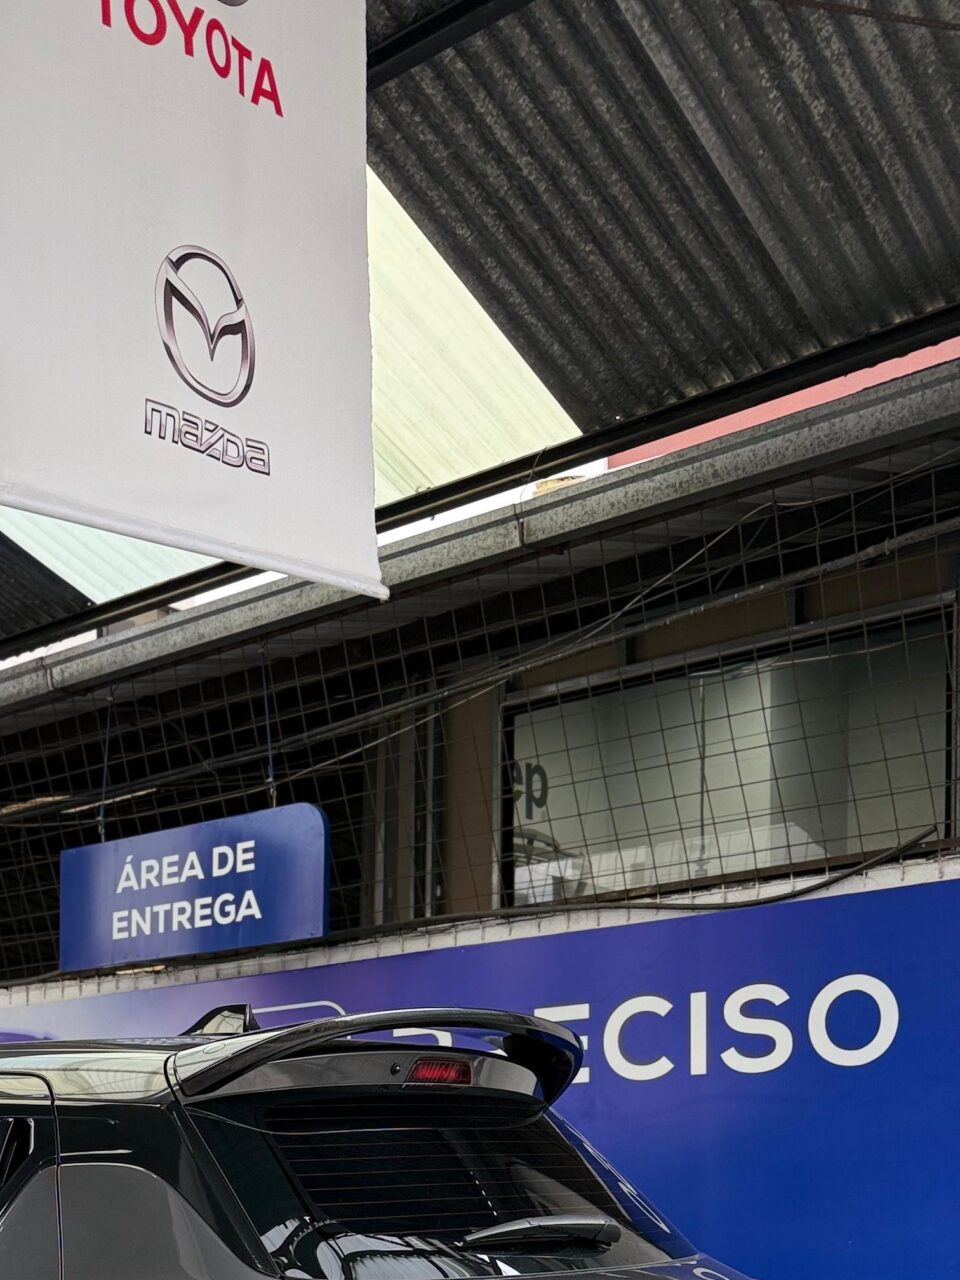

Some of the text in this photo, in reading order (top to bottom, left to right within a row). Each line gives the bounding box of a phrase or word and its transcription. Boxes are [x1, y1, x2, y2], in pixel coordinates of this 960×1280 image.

[144, 397, 271, 476] mazda
[116, 840, 256, 894] ÁREA DE
[112, 890, 263, 940] ENTREGA
